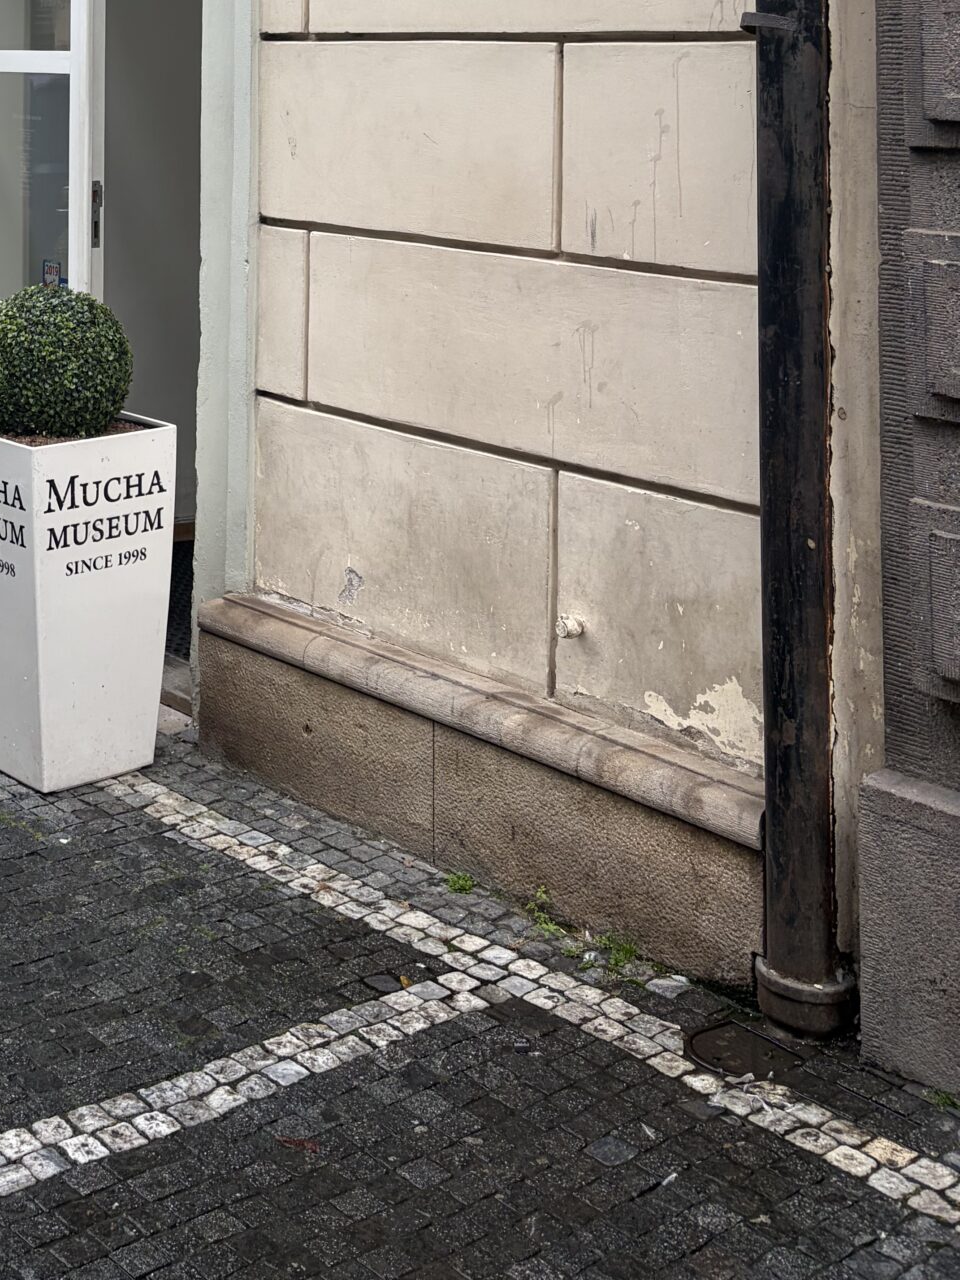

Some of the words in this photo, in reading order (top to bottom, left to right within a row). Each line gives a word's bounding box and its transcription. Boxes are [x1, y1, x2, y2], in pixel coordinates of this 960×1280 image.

[43, 470, 167, 514] MUCHA
[46, 507, 165, 551] MUSEUM
[65, 553, 113, 577] SINCE
[117, 547, 147, 566] 1998
